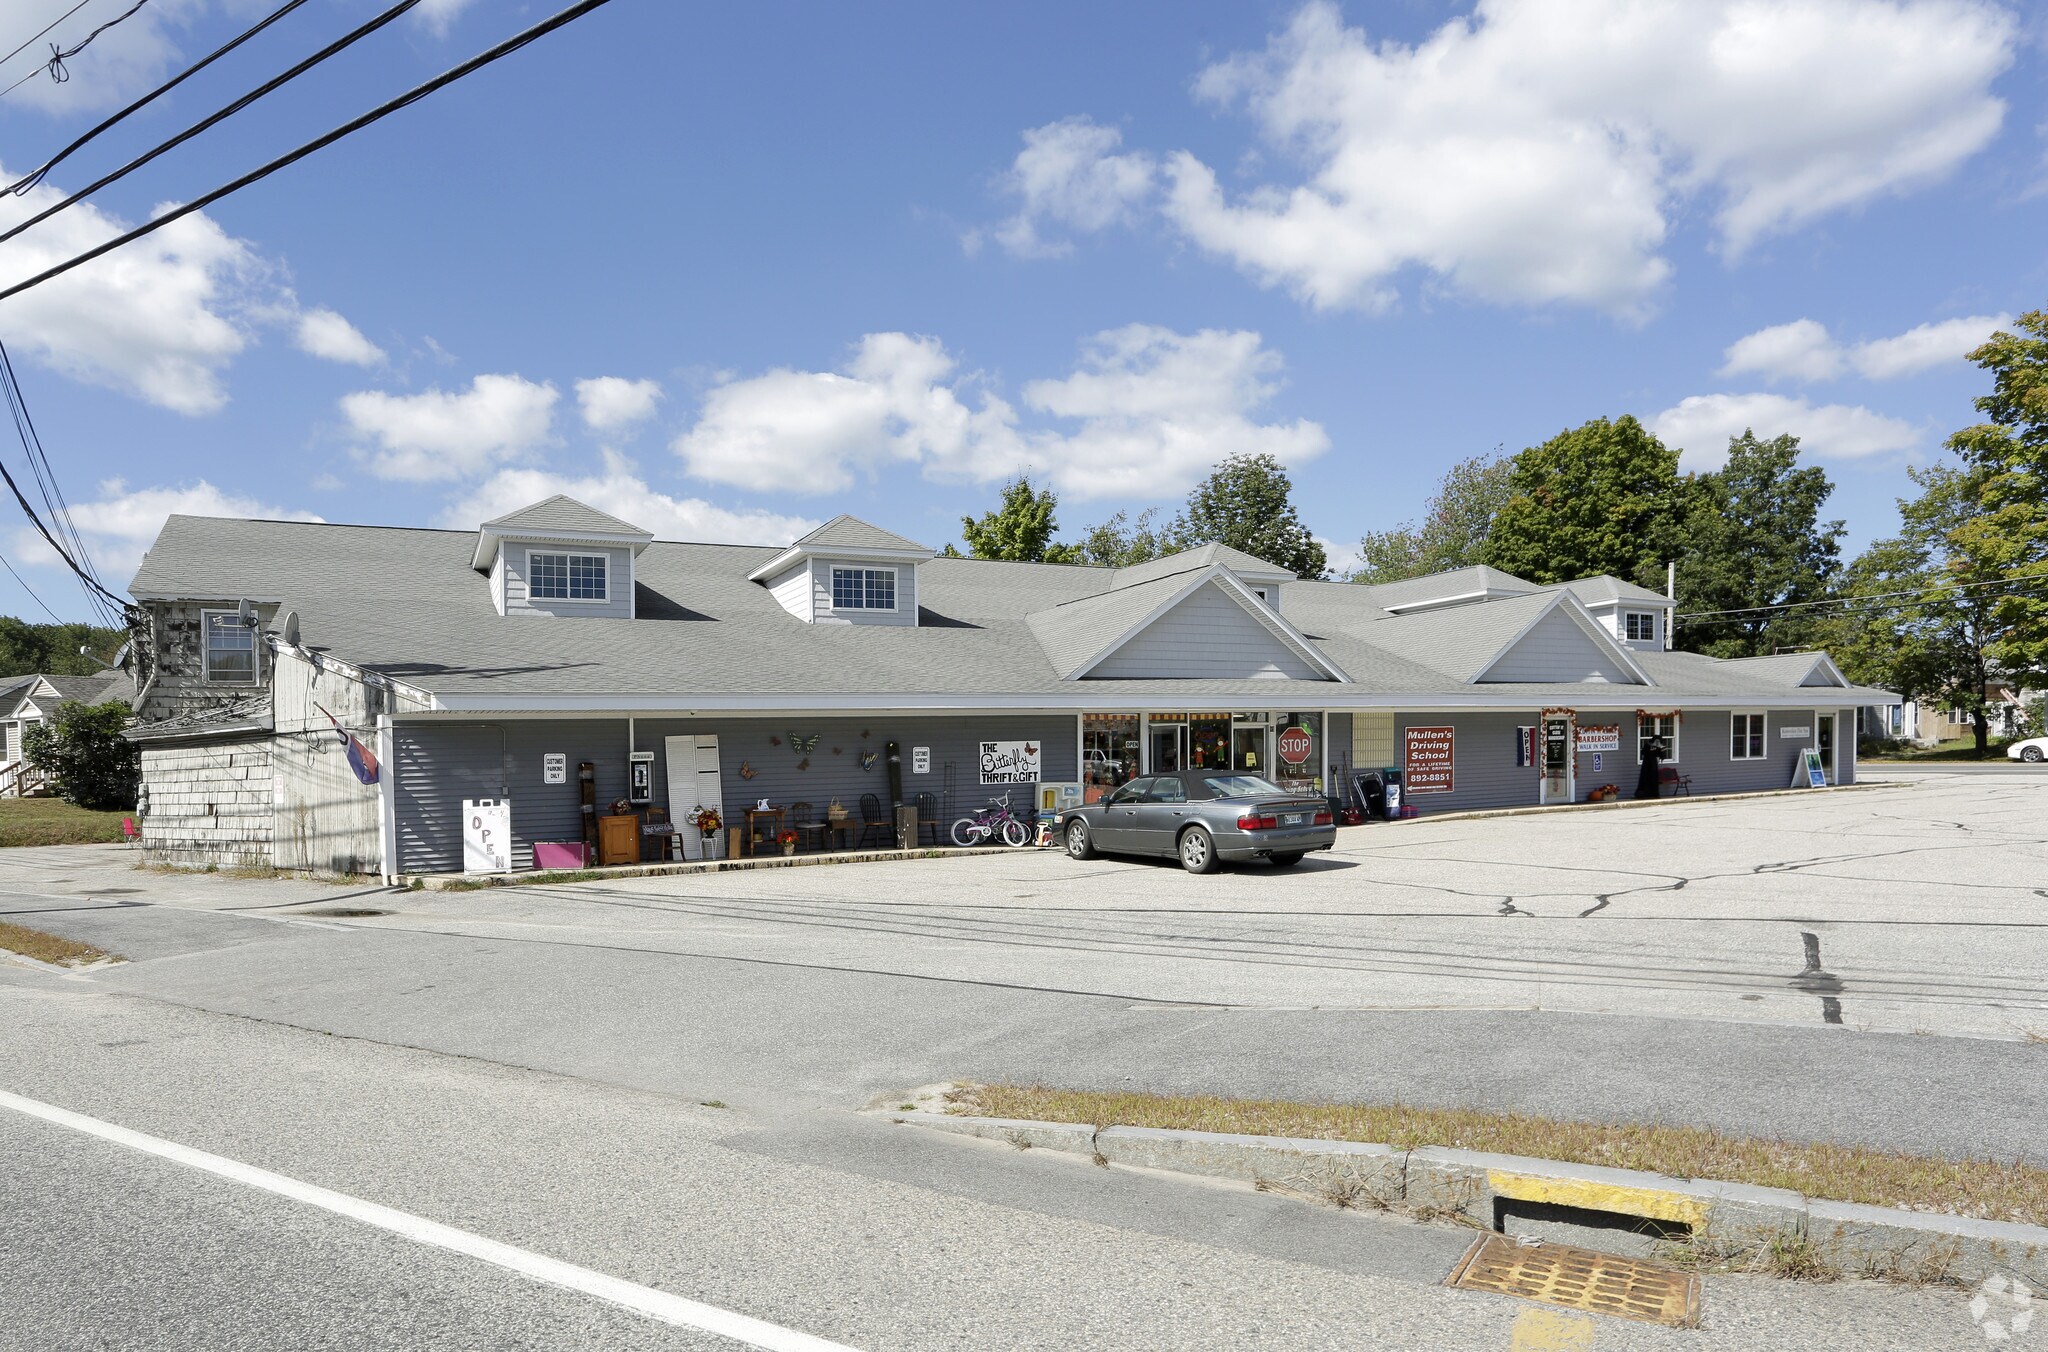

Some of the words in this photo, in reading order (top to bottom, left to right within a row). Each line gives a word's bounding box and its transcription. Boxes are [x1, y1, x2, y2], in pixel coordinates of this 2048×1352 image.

[1407, 731, 1452, 739] Mullen's
[1578, 735, 1617, 743] BARBERSHOP
[982, 743, 997, 753] THE
[1281, 738, 1309, 752] STOP
[1411, 741, 1449, 750] Driving
[1411, 751, 1449, 760] School
[981, 748, 1036, 773] Butterfly
[1411, 773, 1450, 782] 892-8851
[472, 816, 505, 868] OPEN
